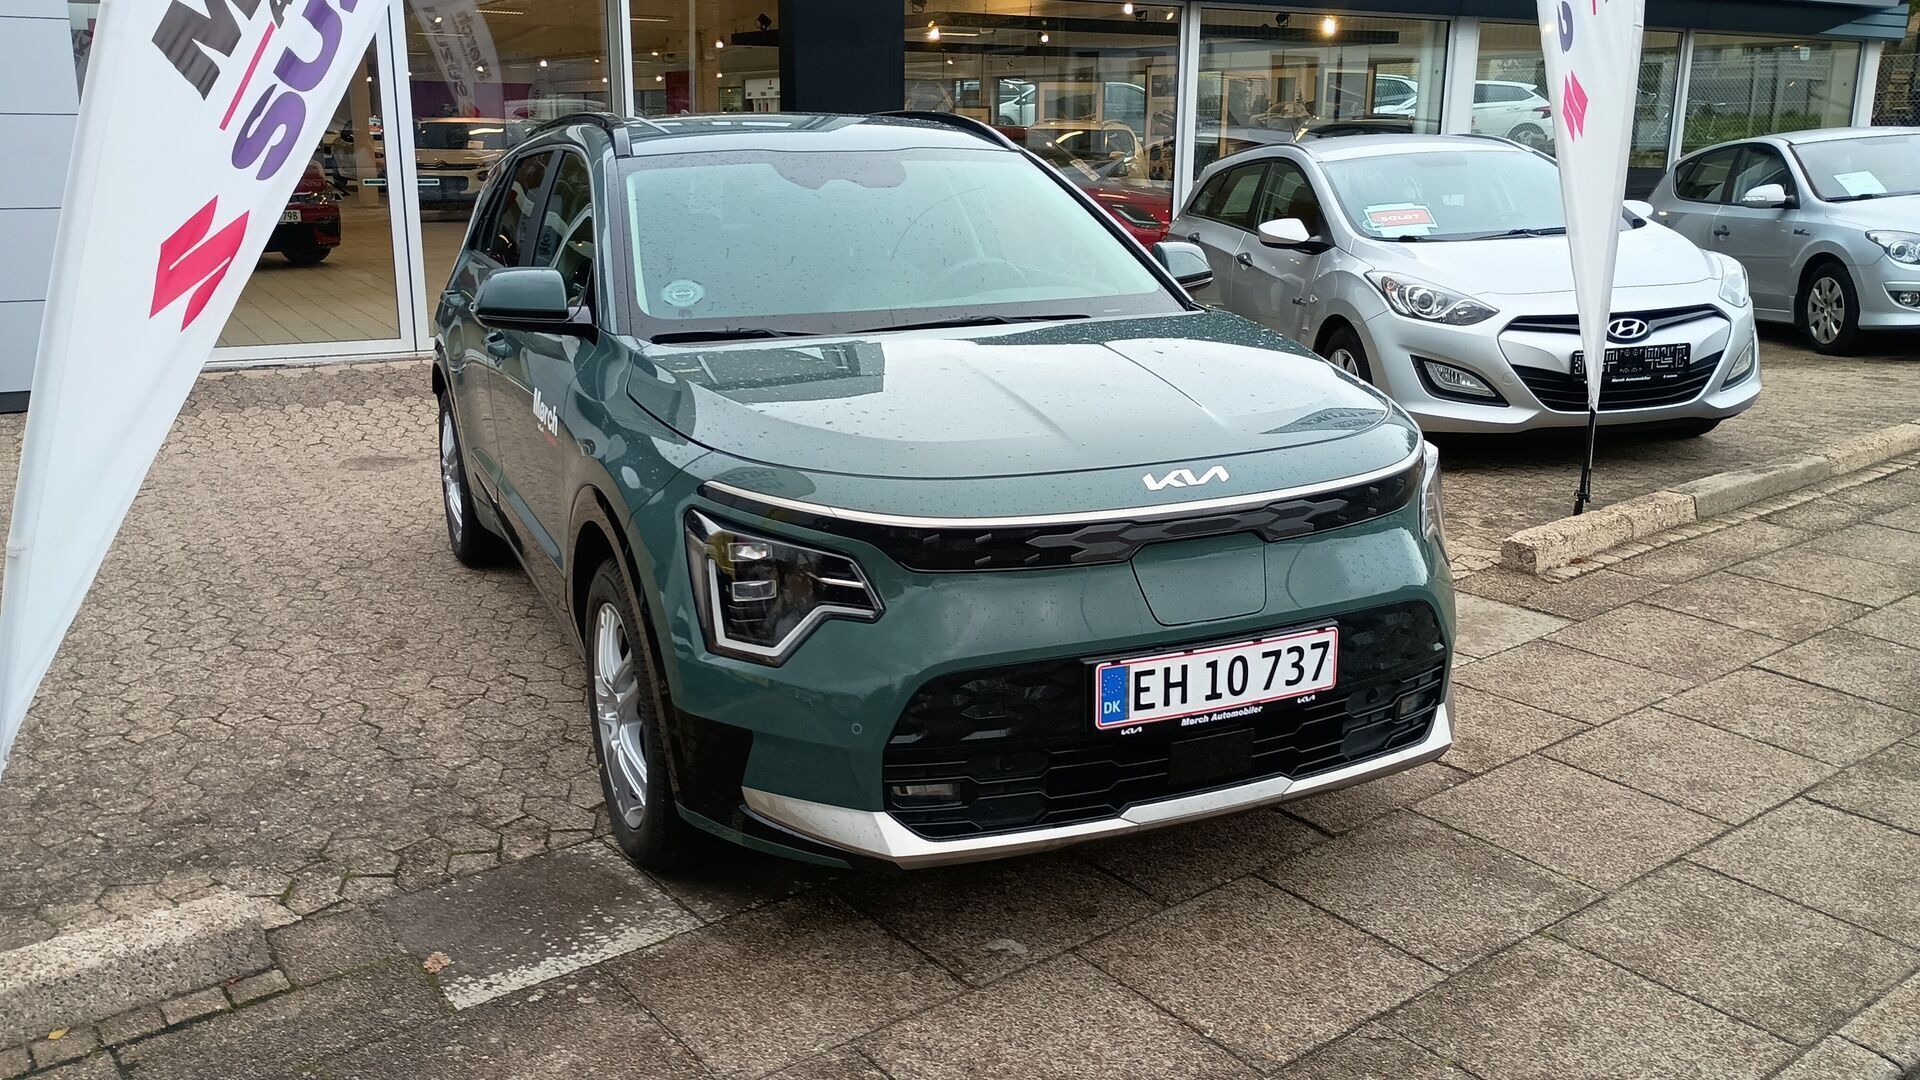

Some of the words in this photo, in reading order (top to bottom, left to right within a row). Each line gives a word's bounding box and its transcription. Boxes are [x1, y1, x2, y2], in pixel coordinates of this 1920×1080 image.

[231, 0, 358, 181] SU
[1143, 465, 1230, 491] KIA
[1134, 664, 1188, 711] EH
[1205, 655, 1249, 701] 10
[1262, 640, 1330, 690] 737
[1103, 700, 1121, 714] DK
[1210, 706, 1263, 721] Automobiler
